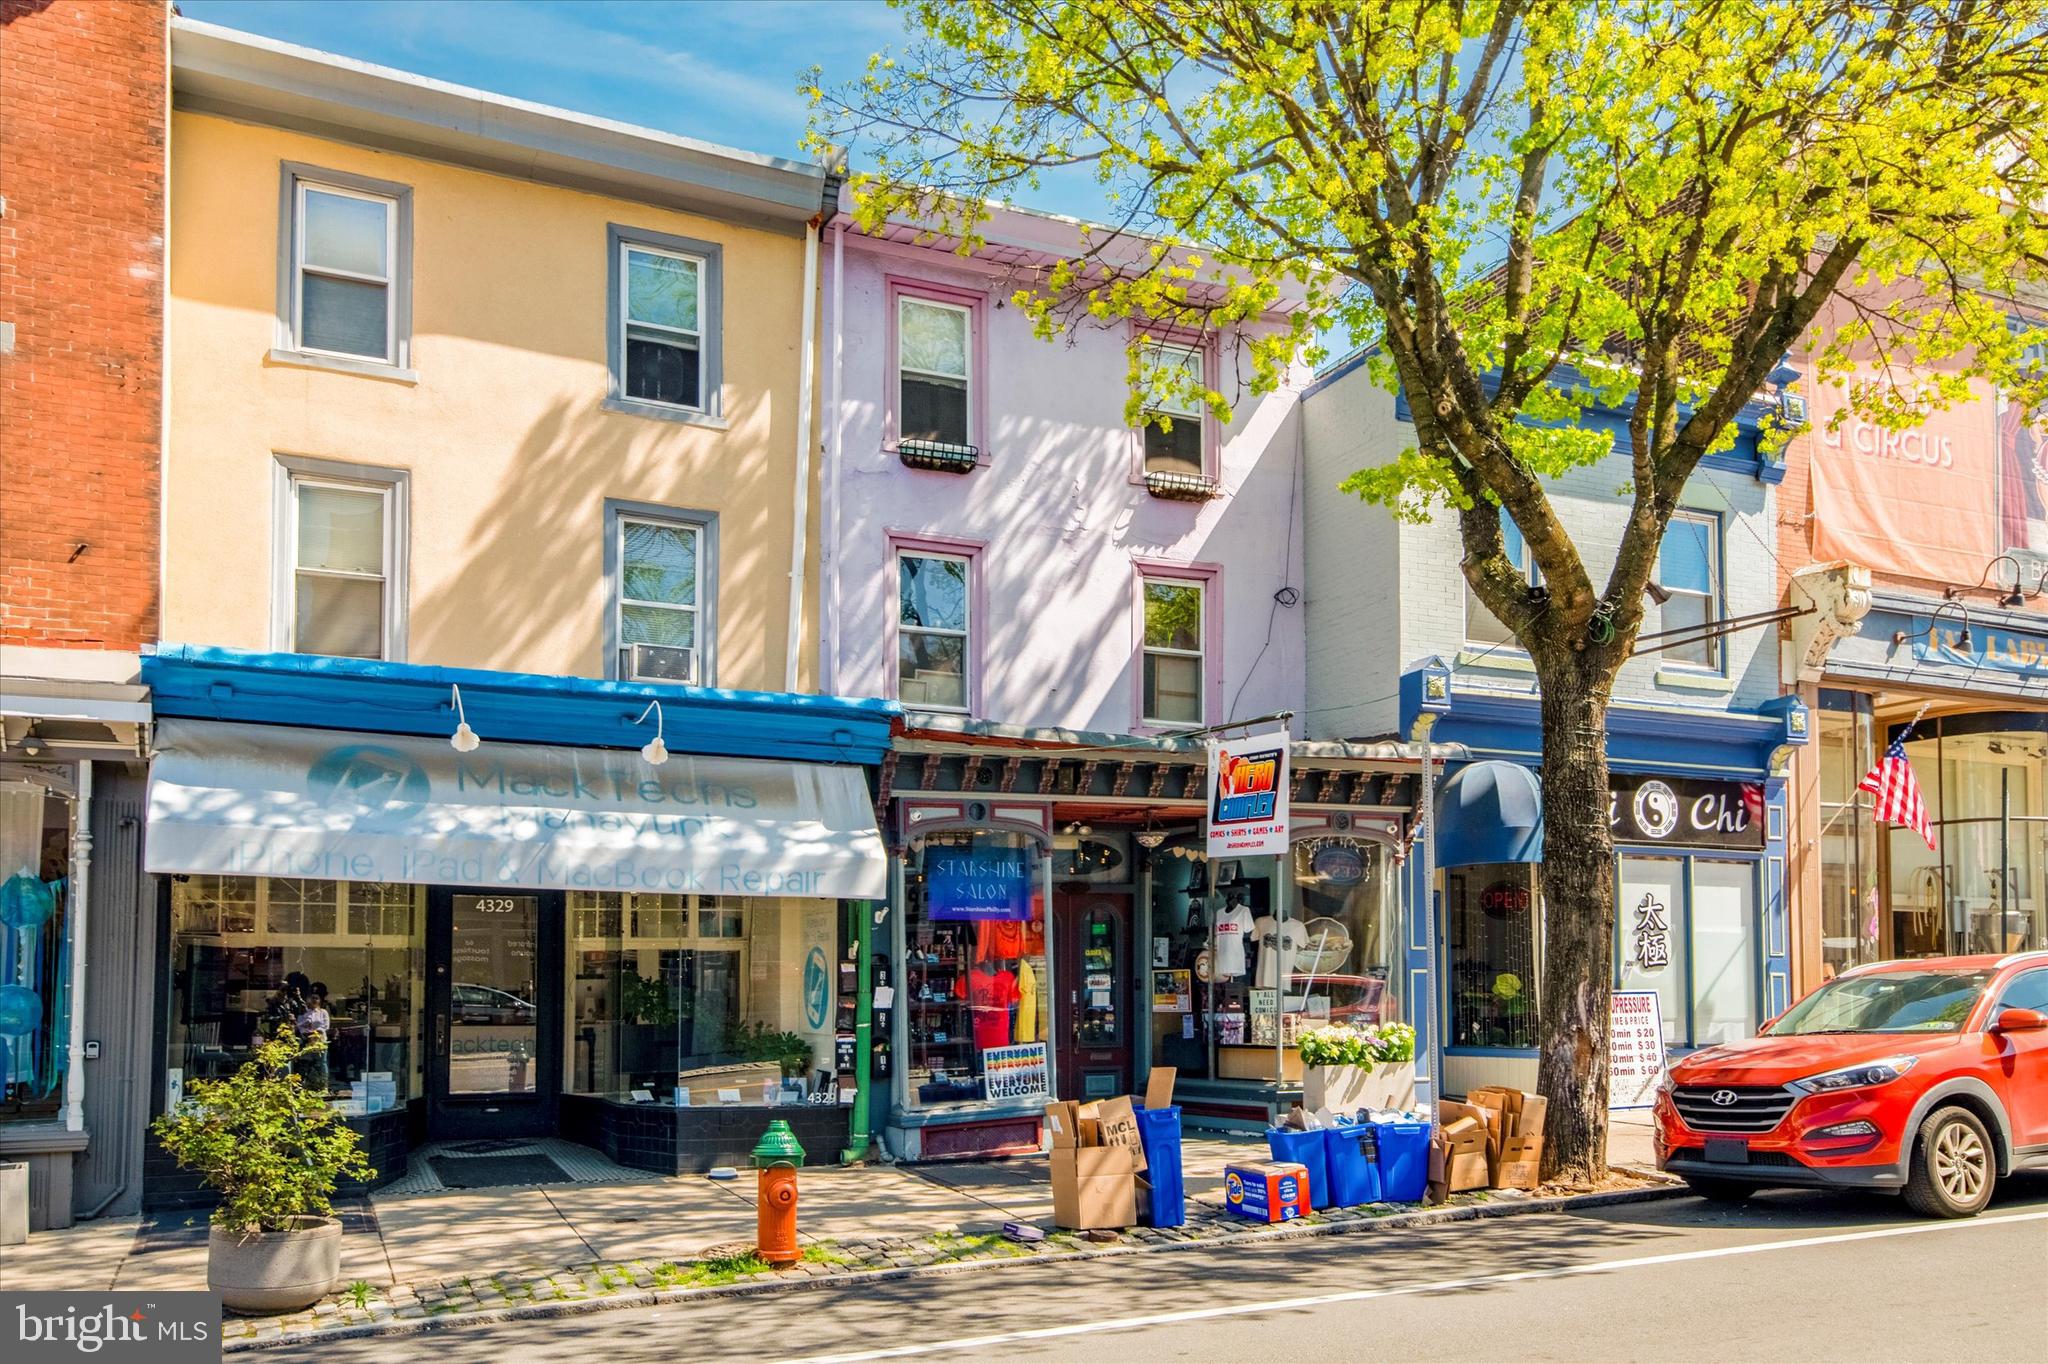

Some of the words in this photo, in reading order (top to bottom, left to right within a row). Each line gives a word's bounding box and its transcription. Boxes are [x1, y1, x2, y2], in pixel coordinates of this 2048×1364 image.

[1854, 422, 1953, 469] CIRCUS
[456, 755, 758, 810] MackTechs
[1690, 793, 1748, 833] Chi
[402, 845, 484, 883] iPad
[499, 851, 519, 884] &
[537, 862, 706, 892] MacBook
[720, 863, 827, 894] Repair
[937, 859, 1025, 878] STARSHINE
[956, 883, 1007, 900] SALON
[475, 899, 514, 912] 4329
[1483, 892, 1529, 909] OPEN
[1637, 892, 1668, 968] 太極
[986, 1046, 1043, 1062] EVERYONE
[988, 1072, 1046, 1089] EVERYONE
[807, 1091, 836, 1105] 4329
[990, 1083, 1047, 1099] WELCOME
[1228, 1179, 1242, 1195] Tide
